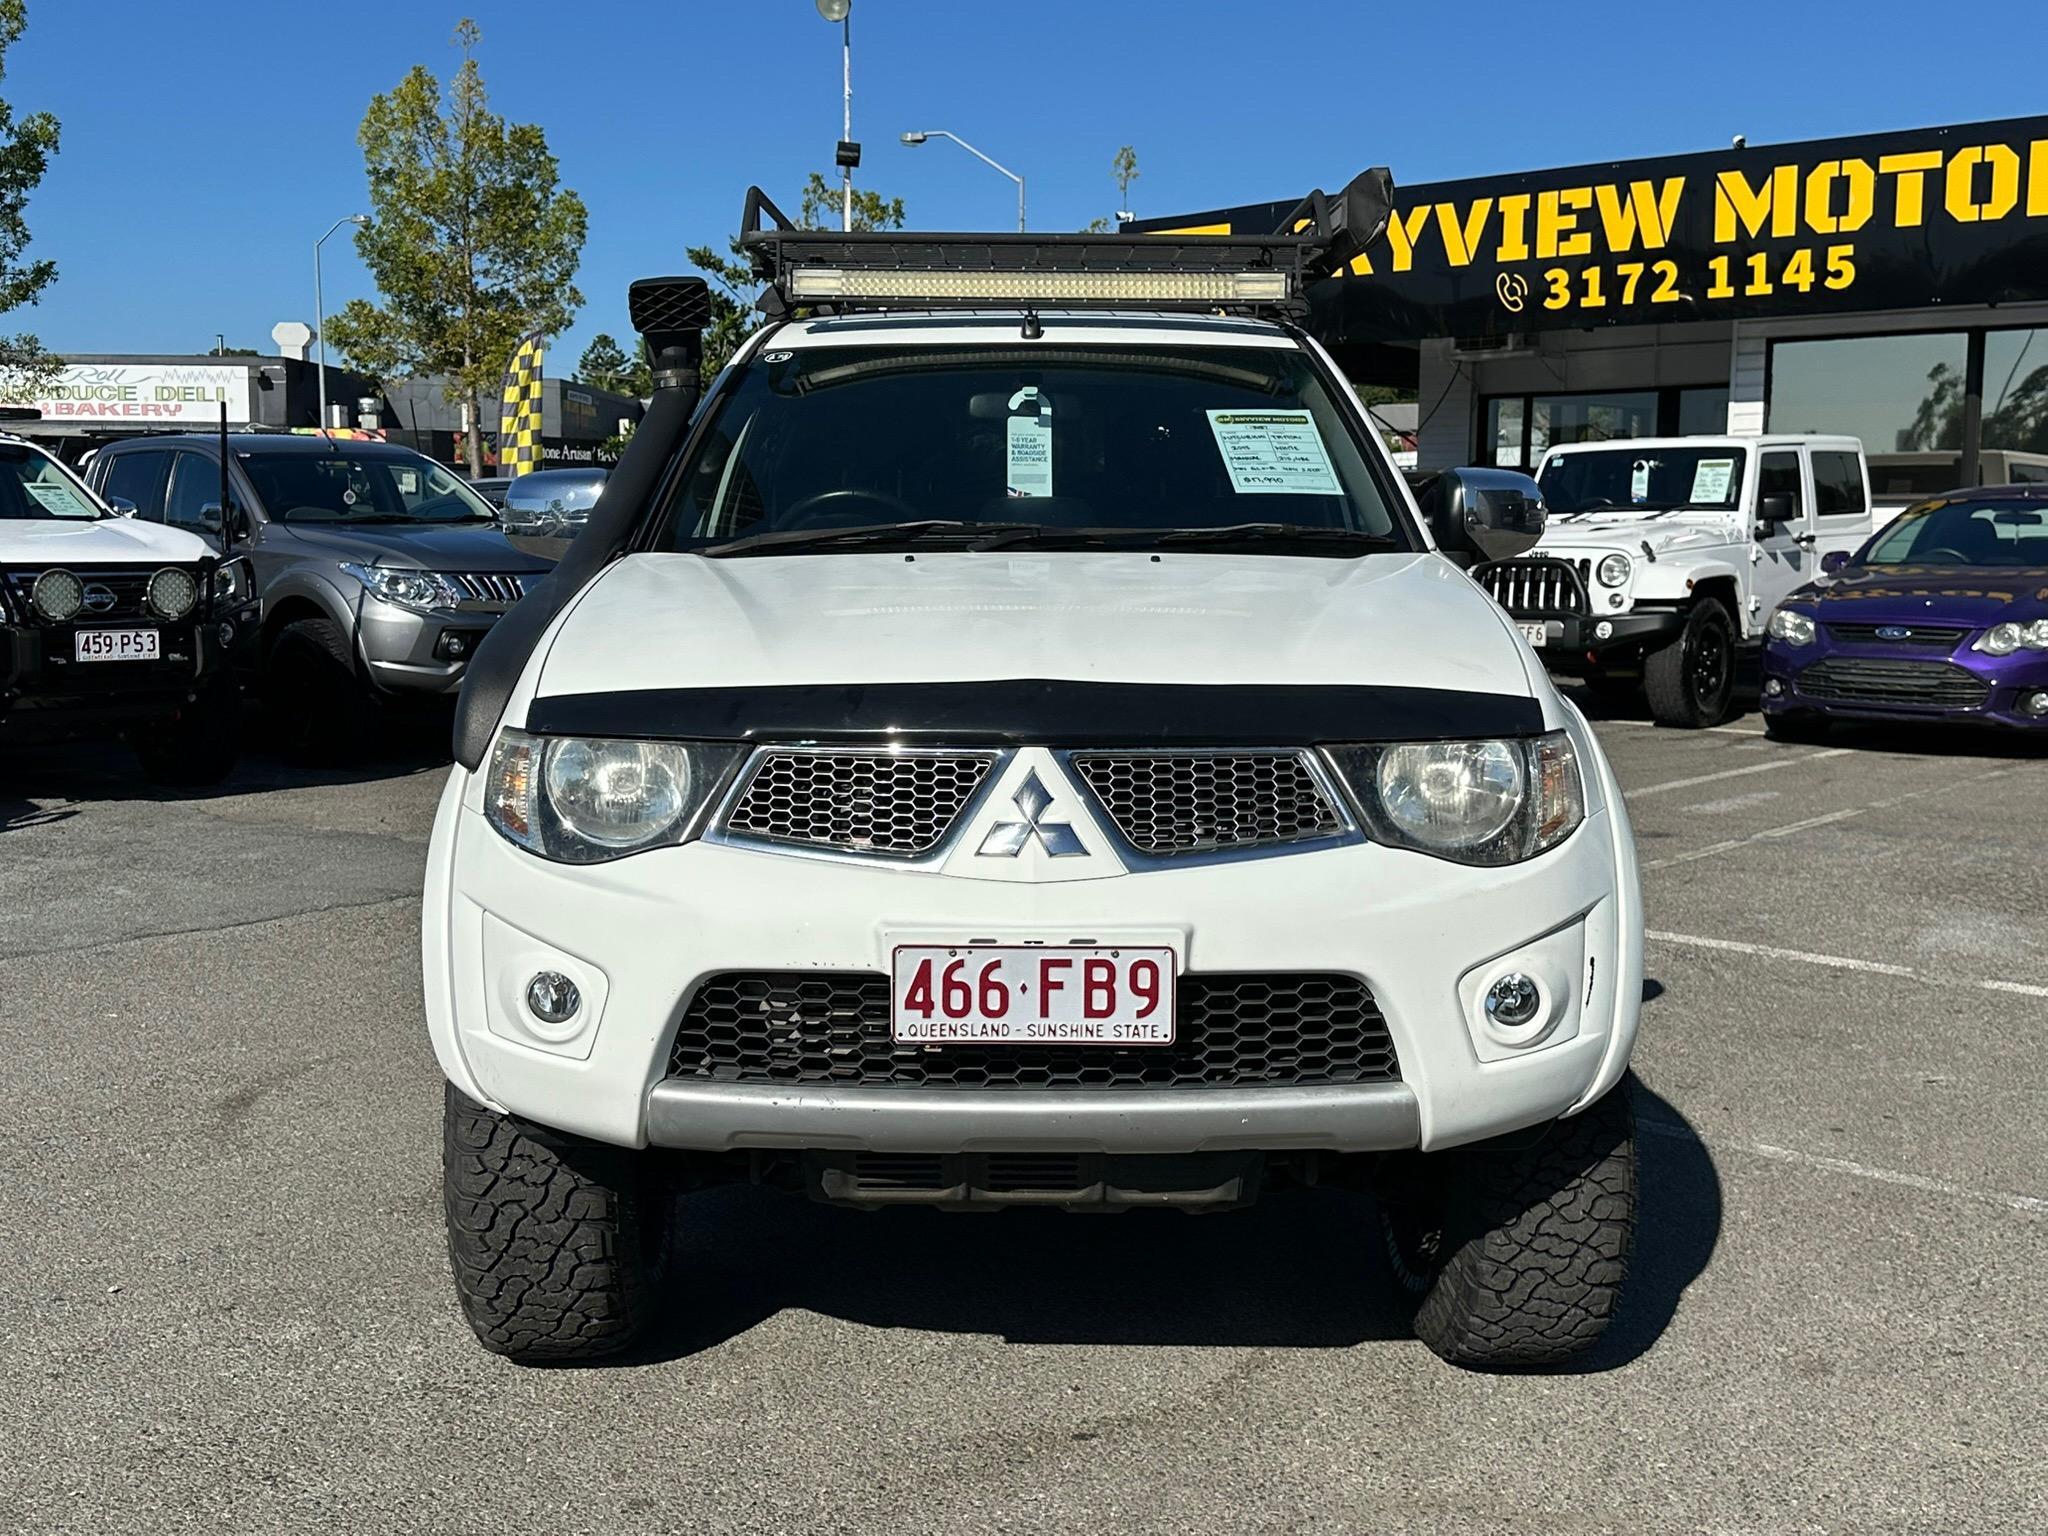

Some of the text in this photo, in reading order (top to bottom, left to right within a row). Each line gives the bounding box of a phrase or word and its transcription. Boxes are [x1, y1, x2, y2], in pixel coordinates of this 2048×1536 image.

[1294, 139, 2048, 278] YVIEW MOTO
[1543, 244, 1856, 310] 3172 1145
[41, 402, 51, 416] &
[55, 403, 182, 417] BAKERY
[81, 632, 156, 654] 459 PS3
[1519, 626, 1543, 641] F6
[904, 958, 1160, 1019] 466 FB9
[908, 1024, 1010, 1038] QUEENSLAND
[1027, 1024, 1104, 1038] SUNSHINE
[1113, 1024, 1160, 1038] STATE
